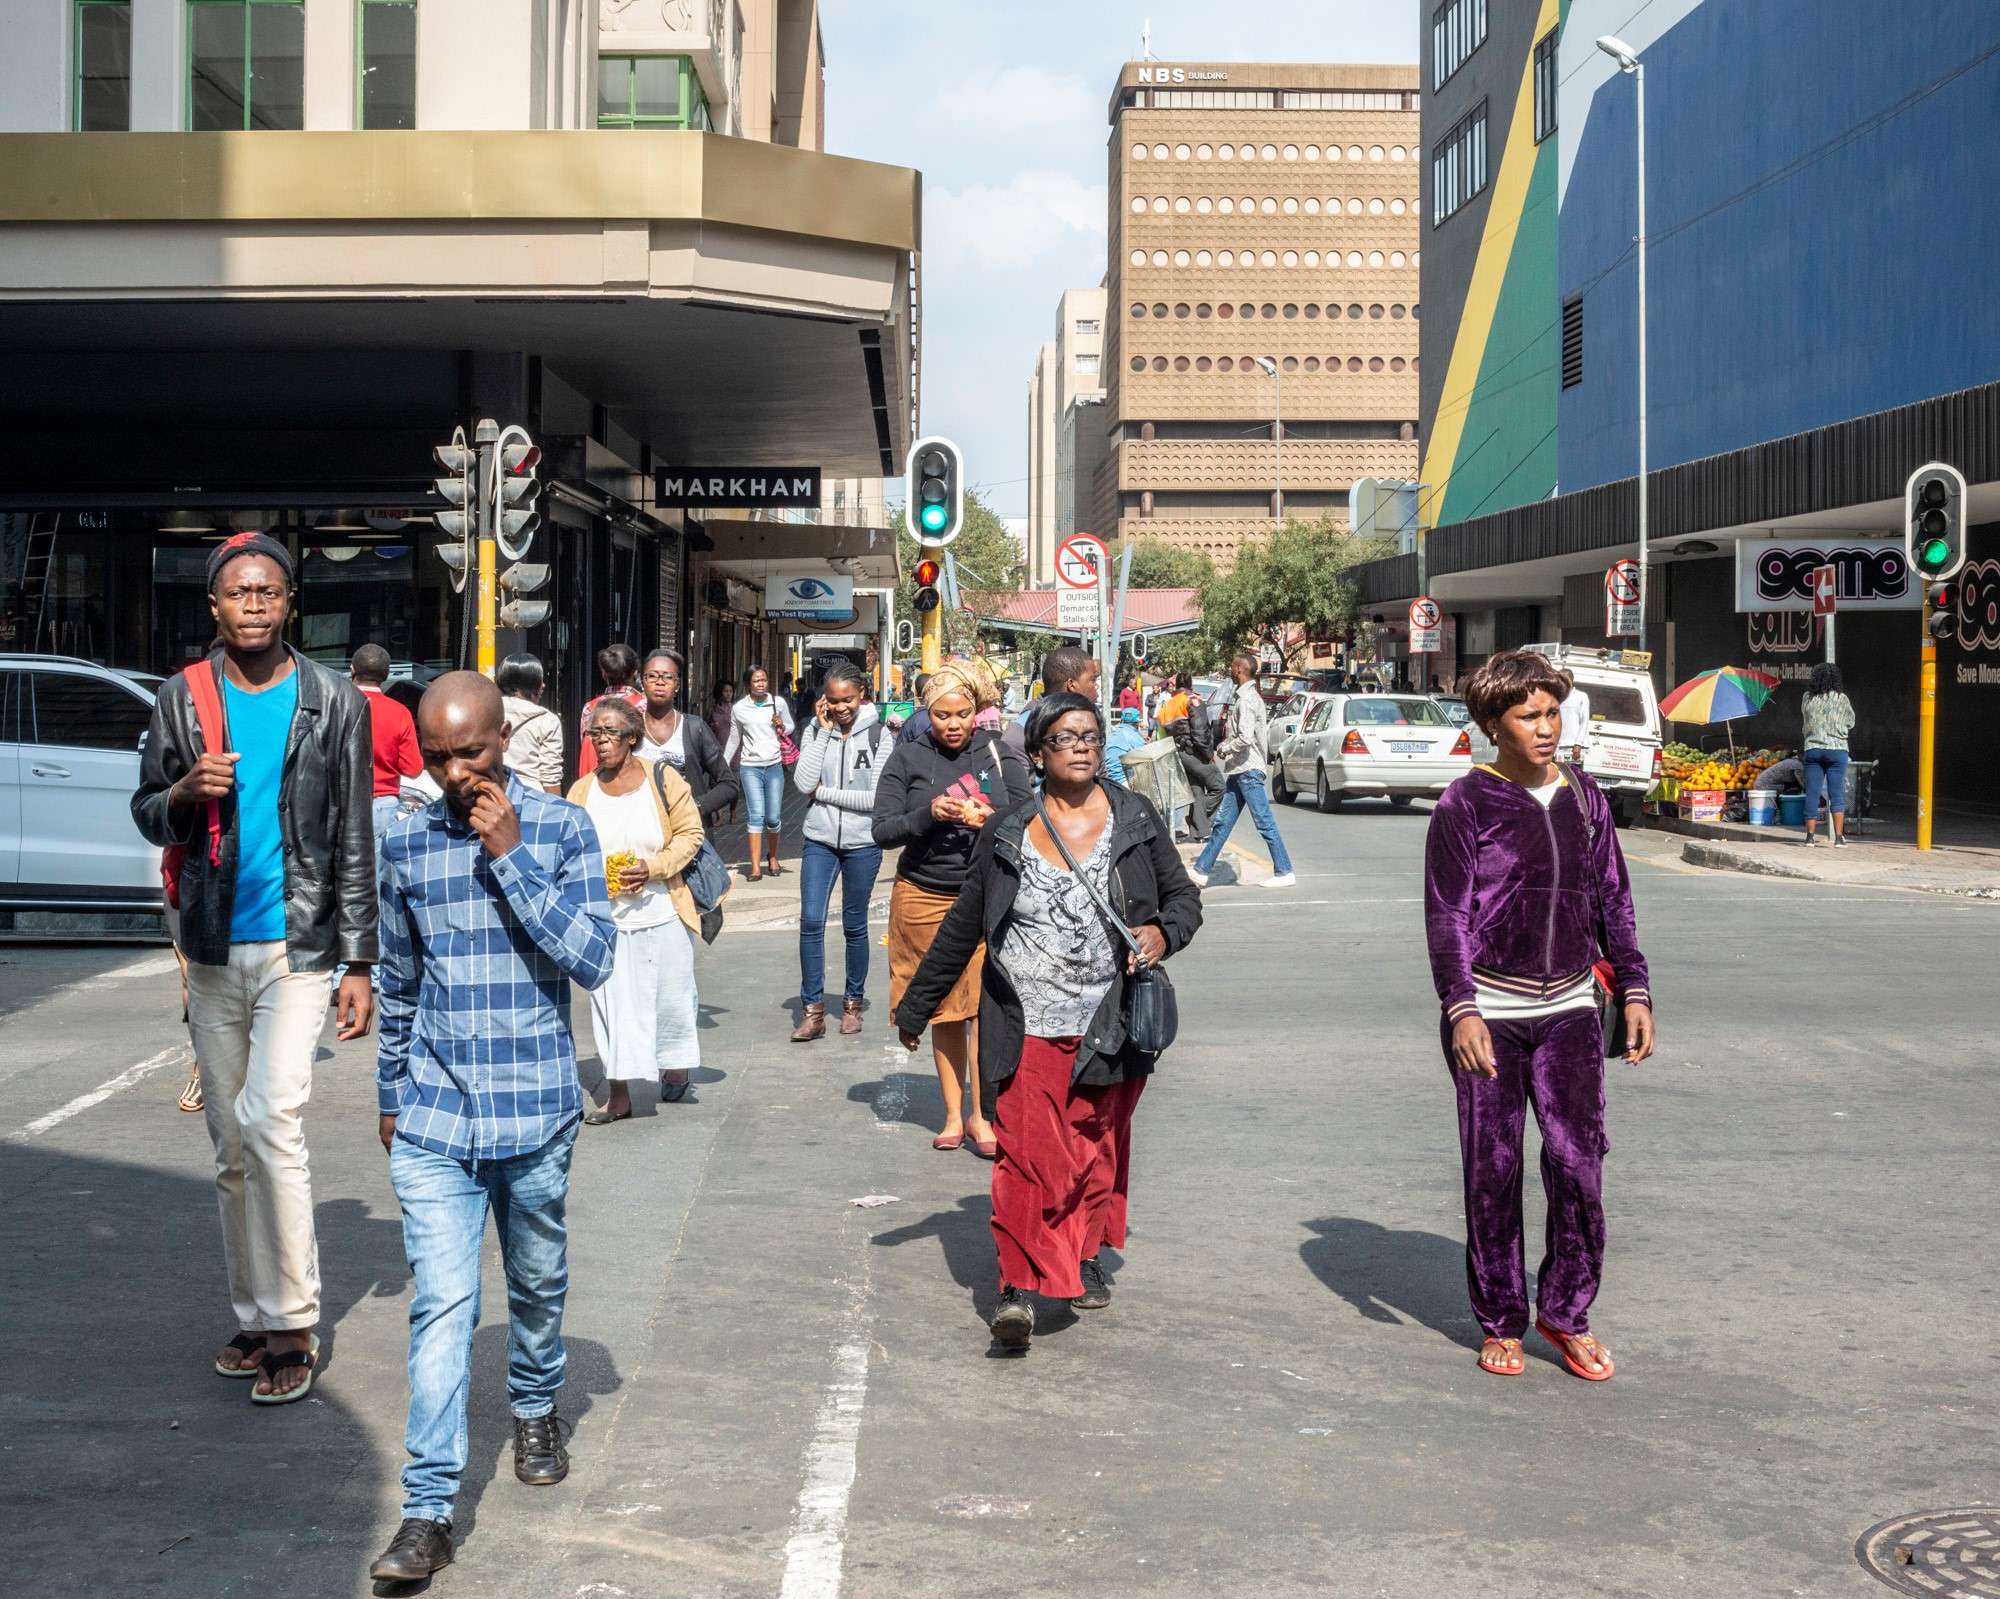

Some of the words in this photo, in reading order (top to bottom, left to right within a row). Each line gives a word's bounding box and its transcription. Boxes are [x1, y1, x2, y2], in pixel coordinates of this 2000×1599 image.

[1139, 68, 1185, 83] NBS
[1188, 72, 1228, 80] BUILDING
[665, 478, 811, 496] MARKHAM
[1757, 548, 1908, 600] game
[1066, 593, 1099, 601] OUTSIDE
[767, 610, 780, 618] We
[780, 610, 797, 618] Test
[797, 610, 815, 619] Eyes
[1060, 604, 1099, 612] Demarcat
[1063, 615, 1099, 623] Stalls/Si
[1782, 663, 1794, 680] Live
[1794, 663, 1812, 680] Better
[1957, 664, 1977, 684] Save
[854, 750, 871, 769] A
